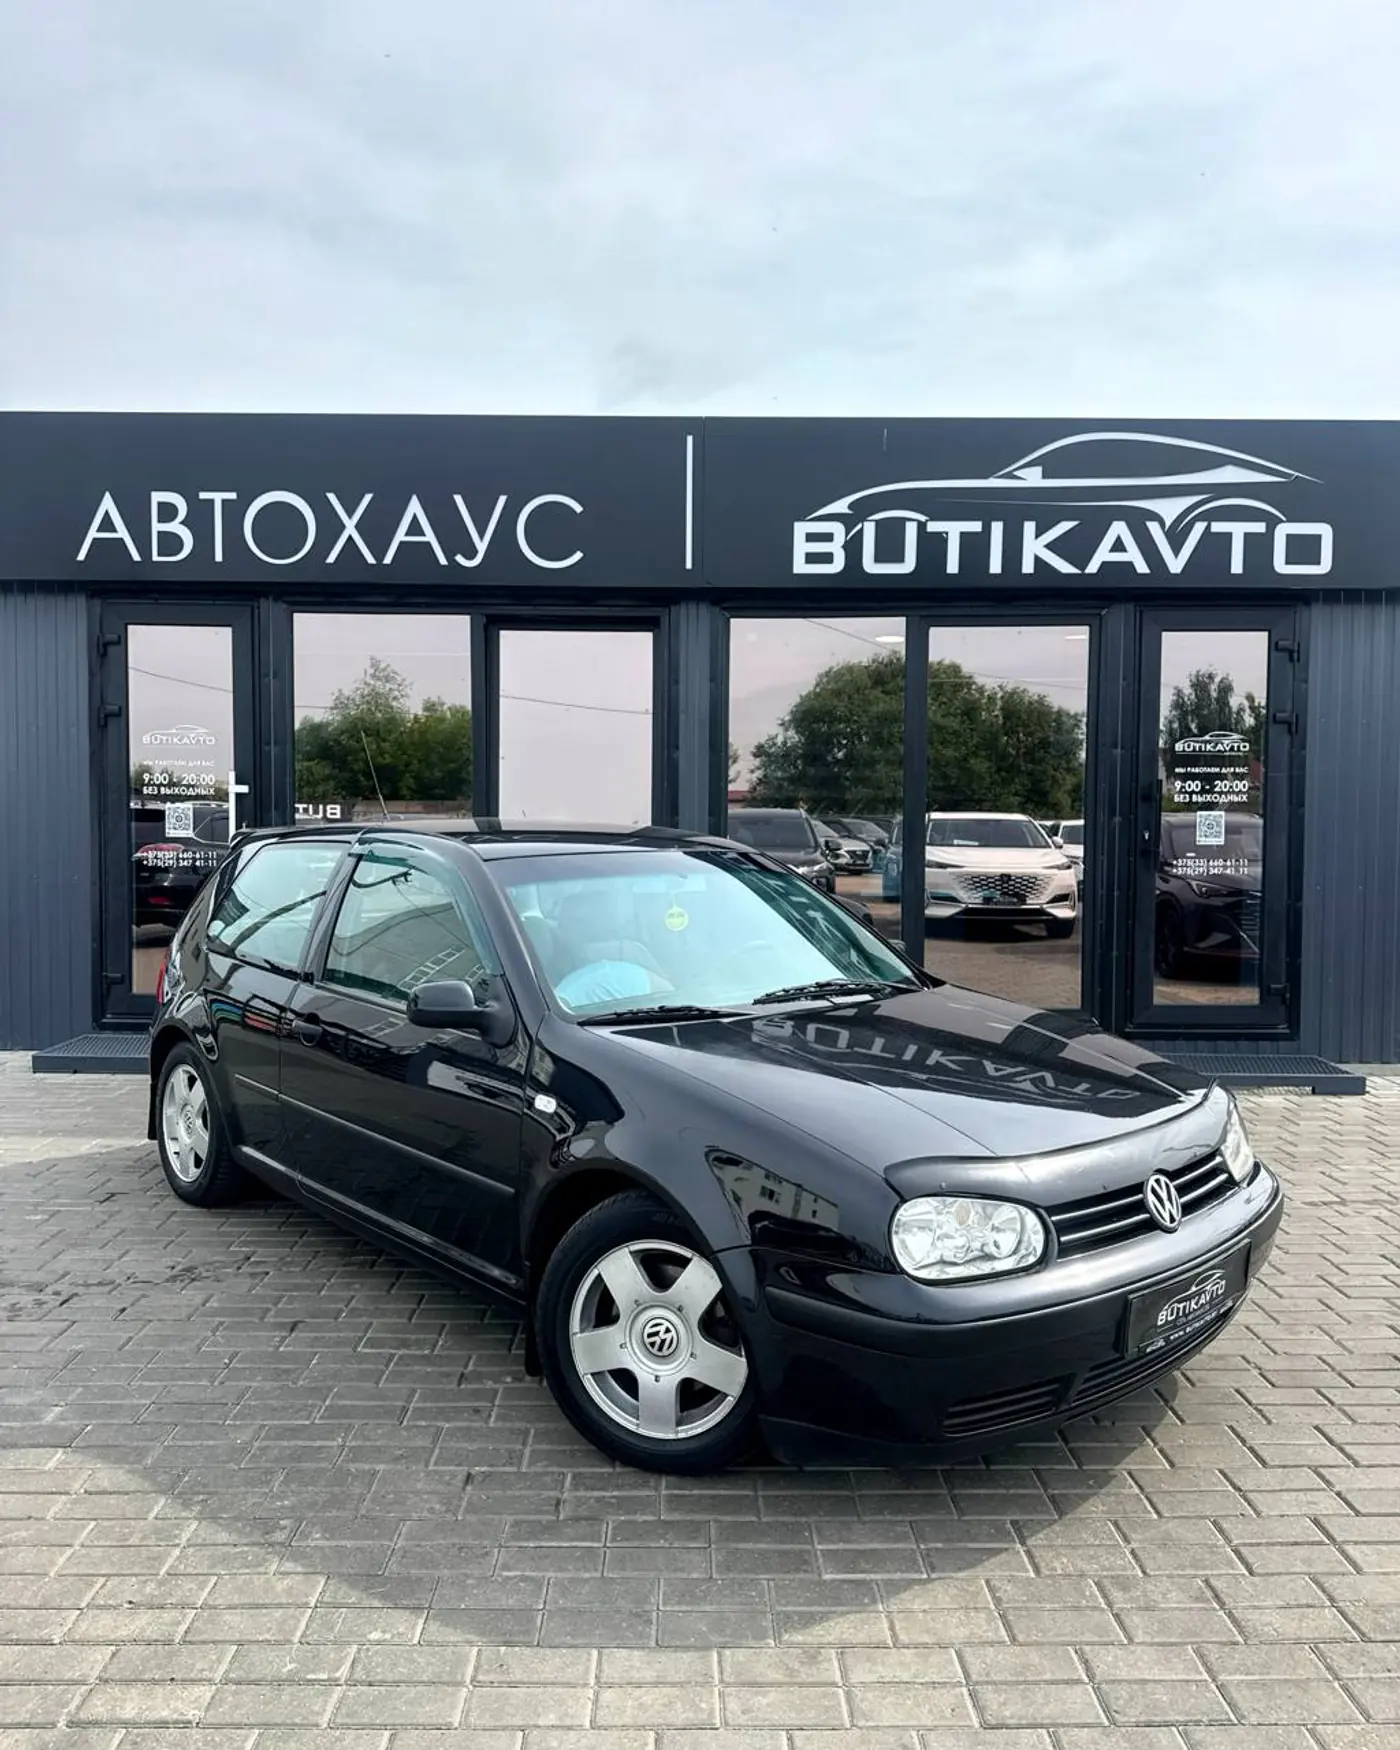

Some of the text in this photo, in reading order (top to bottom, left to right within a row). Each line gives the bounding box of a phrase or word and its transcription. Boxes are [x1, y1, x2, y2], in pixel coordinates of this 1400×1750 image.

[76, 490, 585, 570] АВТОХАУС
[792, 520, 1334, 576] BUTIKAVTO
[142, 735, 216, 745] BUTIKAVTO
[1174, 742, 1250, 752] BUTIKAVTO
[143, 772, 169, 785] 9:00
[181, 773, 216, 785] 20:00
[143, 786, 215, 796] БЕЗ ВЫХОДНЫХ
[1174, 780, 1201, 792] 9:00
[1214, 780, 1248, 792] 20:00
[1174, 794, 1248, 803] БЕЗ ВЫХОДНЫХ
[1156, 1279, 1226, 1326] BUTIKAVTO
